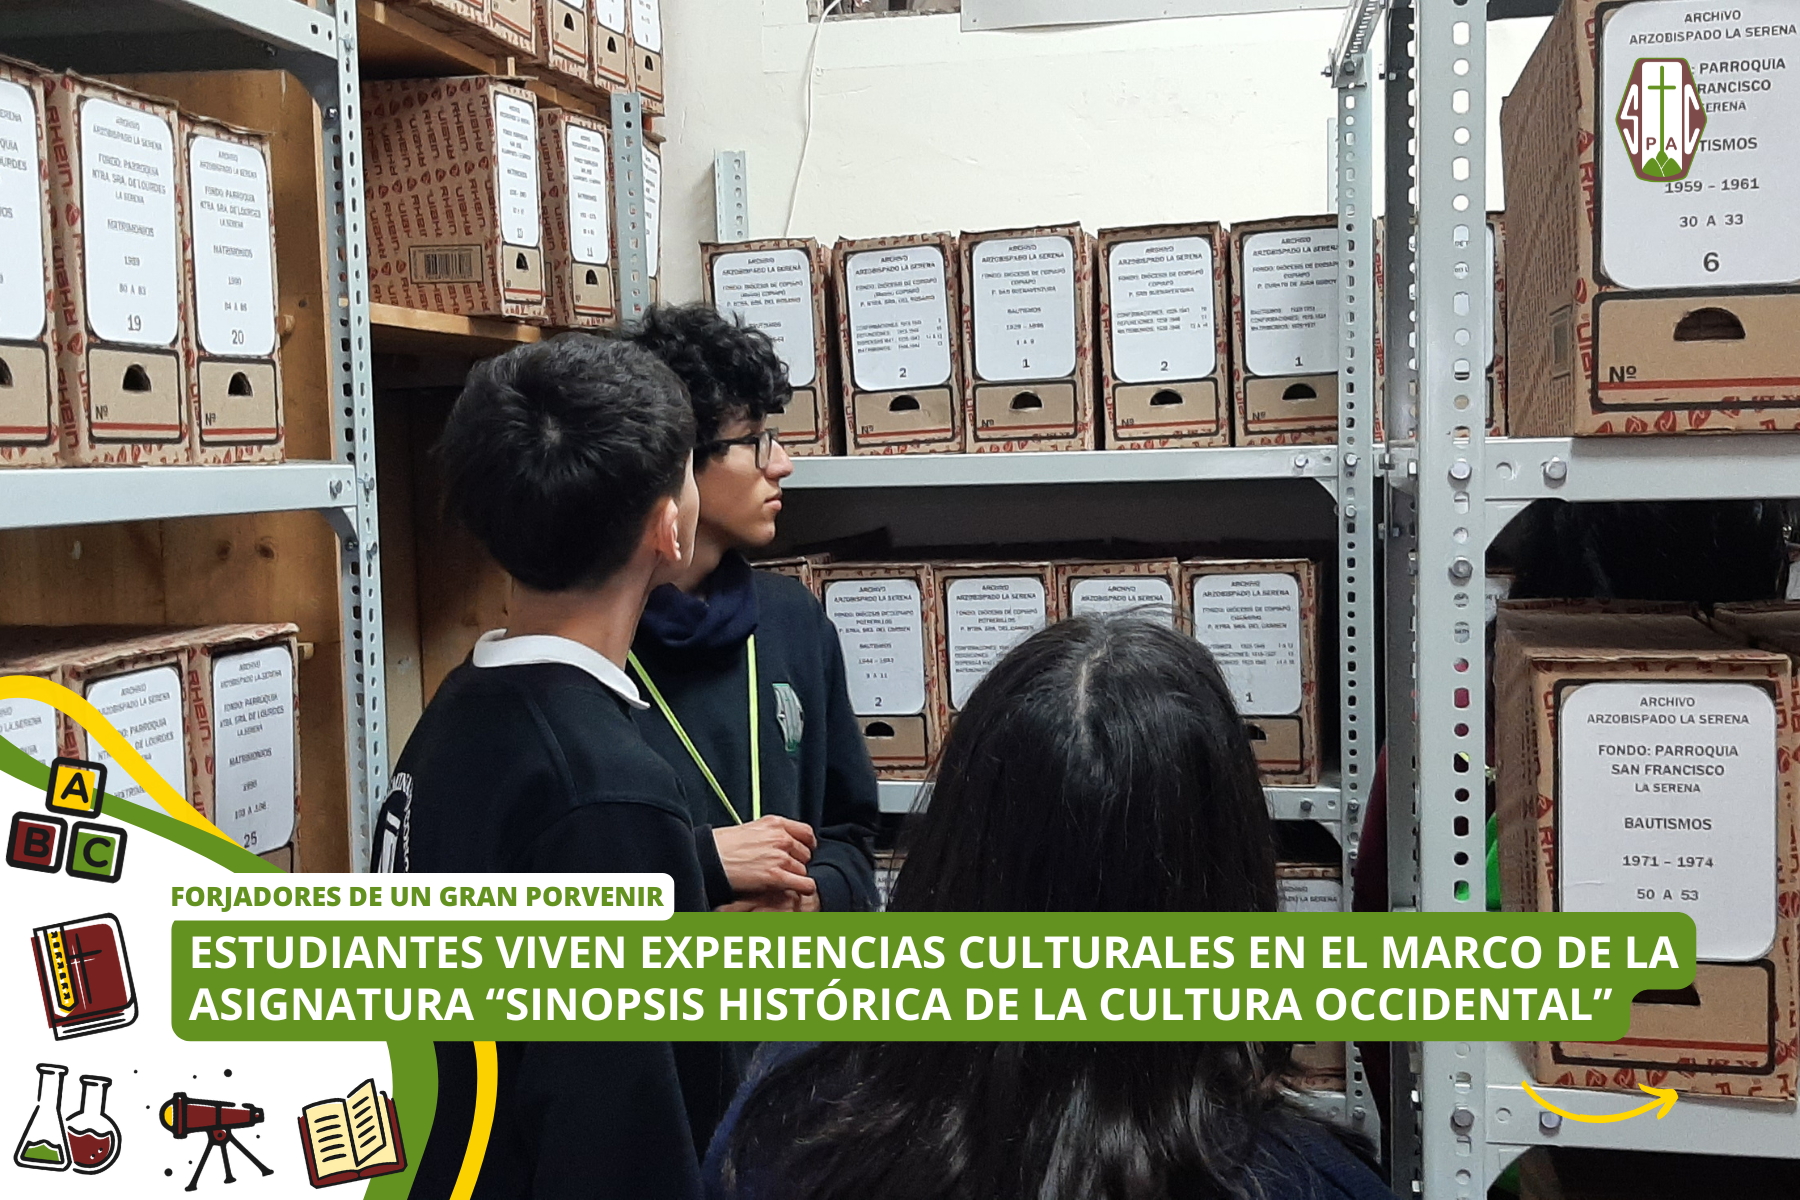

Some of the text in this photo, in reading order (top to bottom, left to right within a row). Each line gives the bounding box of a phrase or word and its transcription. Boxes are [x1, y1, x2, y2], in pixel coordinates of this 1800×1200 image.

[1684, 9, 1741, 24] ARCHIVO
[1629, 24, 1797, 45] ARZOBISPADO LA SERENA
[1699, 58, 1786, 75] PARROQUIA
[1697, 80, 1771, 95] RANCISCO
[1701, 101, 1746, 113] ERENA
[1699, 137, 1758, 152] TISMOS
[1664, 178, 1760, 194] 1959 1961
[1679, 214, 1744, 228] 30 A 33
[1703, 252, 1720, 272] 6
[128, 314, 141, 331] 19
[232, 330, 244, 344] 20
[1023, 359, 1030, 368] 1
[1161, 361, 1168, 371] 2
[1295, 357, 1303, 366] 1
[900, 368, 906, 377] 2
[875, 697, 882, 707] 2
[1246, 693, 1253, 702] 1
[1640, 697, 1695, 707] ARCHIVO
[1587, 714, 1750, 725] ARZOBISPADO LA SERENA
[1598, 745, 1739, 758] FONDO: PARROQUIA
[1611, 764, 1725, 776] SAN FRANCISCO
[1635, 783, 1701, 793] LA SERENA
[1624, 818, 1712, 830] BAUTISMOS
[244, 831, 257, 848] 25
[1622, 855, 1714, 868] 1971 1974
[1637, 889, 1699, 901] 50 A 53
